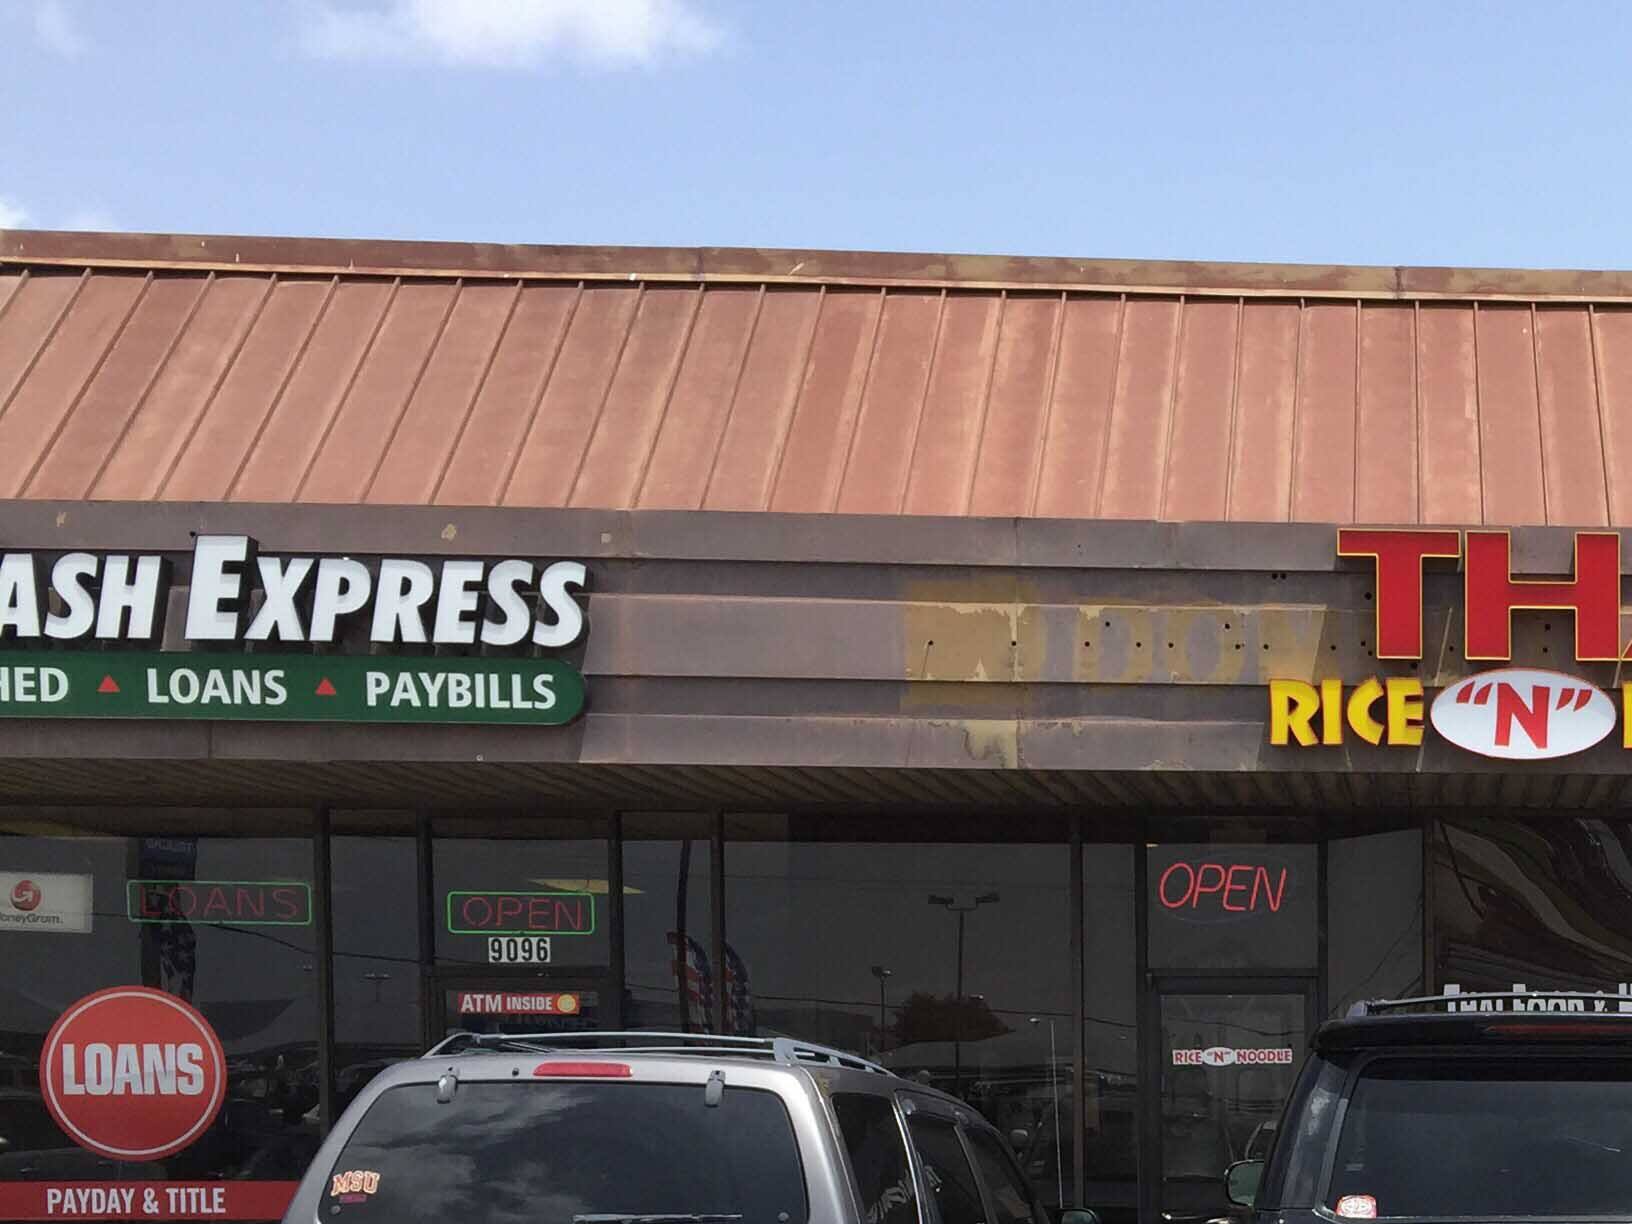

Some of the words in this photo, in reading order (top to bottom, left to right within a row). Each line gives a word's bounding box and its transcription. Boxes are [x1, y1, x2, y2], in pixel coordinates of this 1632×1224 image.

[185, 534, 587, 648] EXPRESS
[146, 667, 288, 705] LOANS
[366, 670, 556, 710] PAYBILLS
[1269, 677, 1426, 748] RICE
[139, 885, 299, 918] LOANS
[1158, 861, 1288, 913] OPEN
[462, 896, 583, 931] OPEN
[490, 938, 549, 962] 9096
[460, 993, 502, 1013] ATM
[506, 996, 553, 1011] INSIDE
[61, 1042, 205, 1096] LOANS
[1173, 1050, 1202, 1064] RICE
[1235, 1049, 1292, 1064] NOODLE
[46, 1187, 135, 1215] PAYDAY
[141, 1187, 160, 1214] &
[165, 1187, 227, 1214] TITLE
